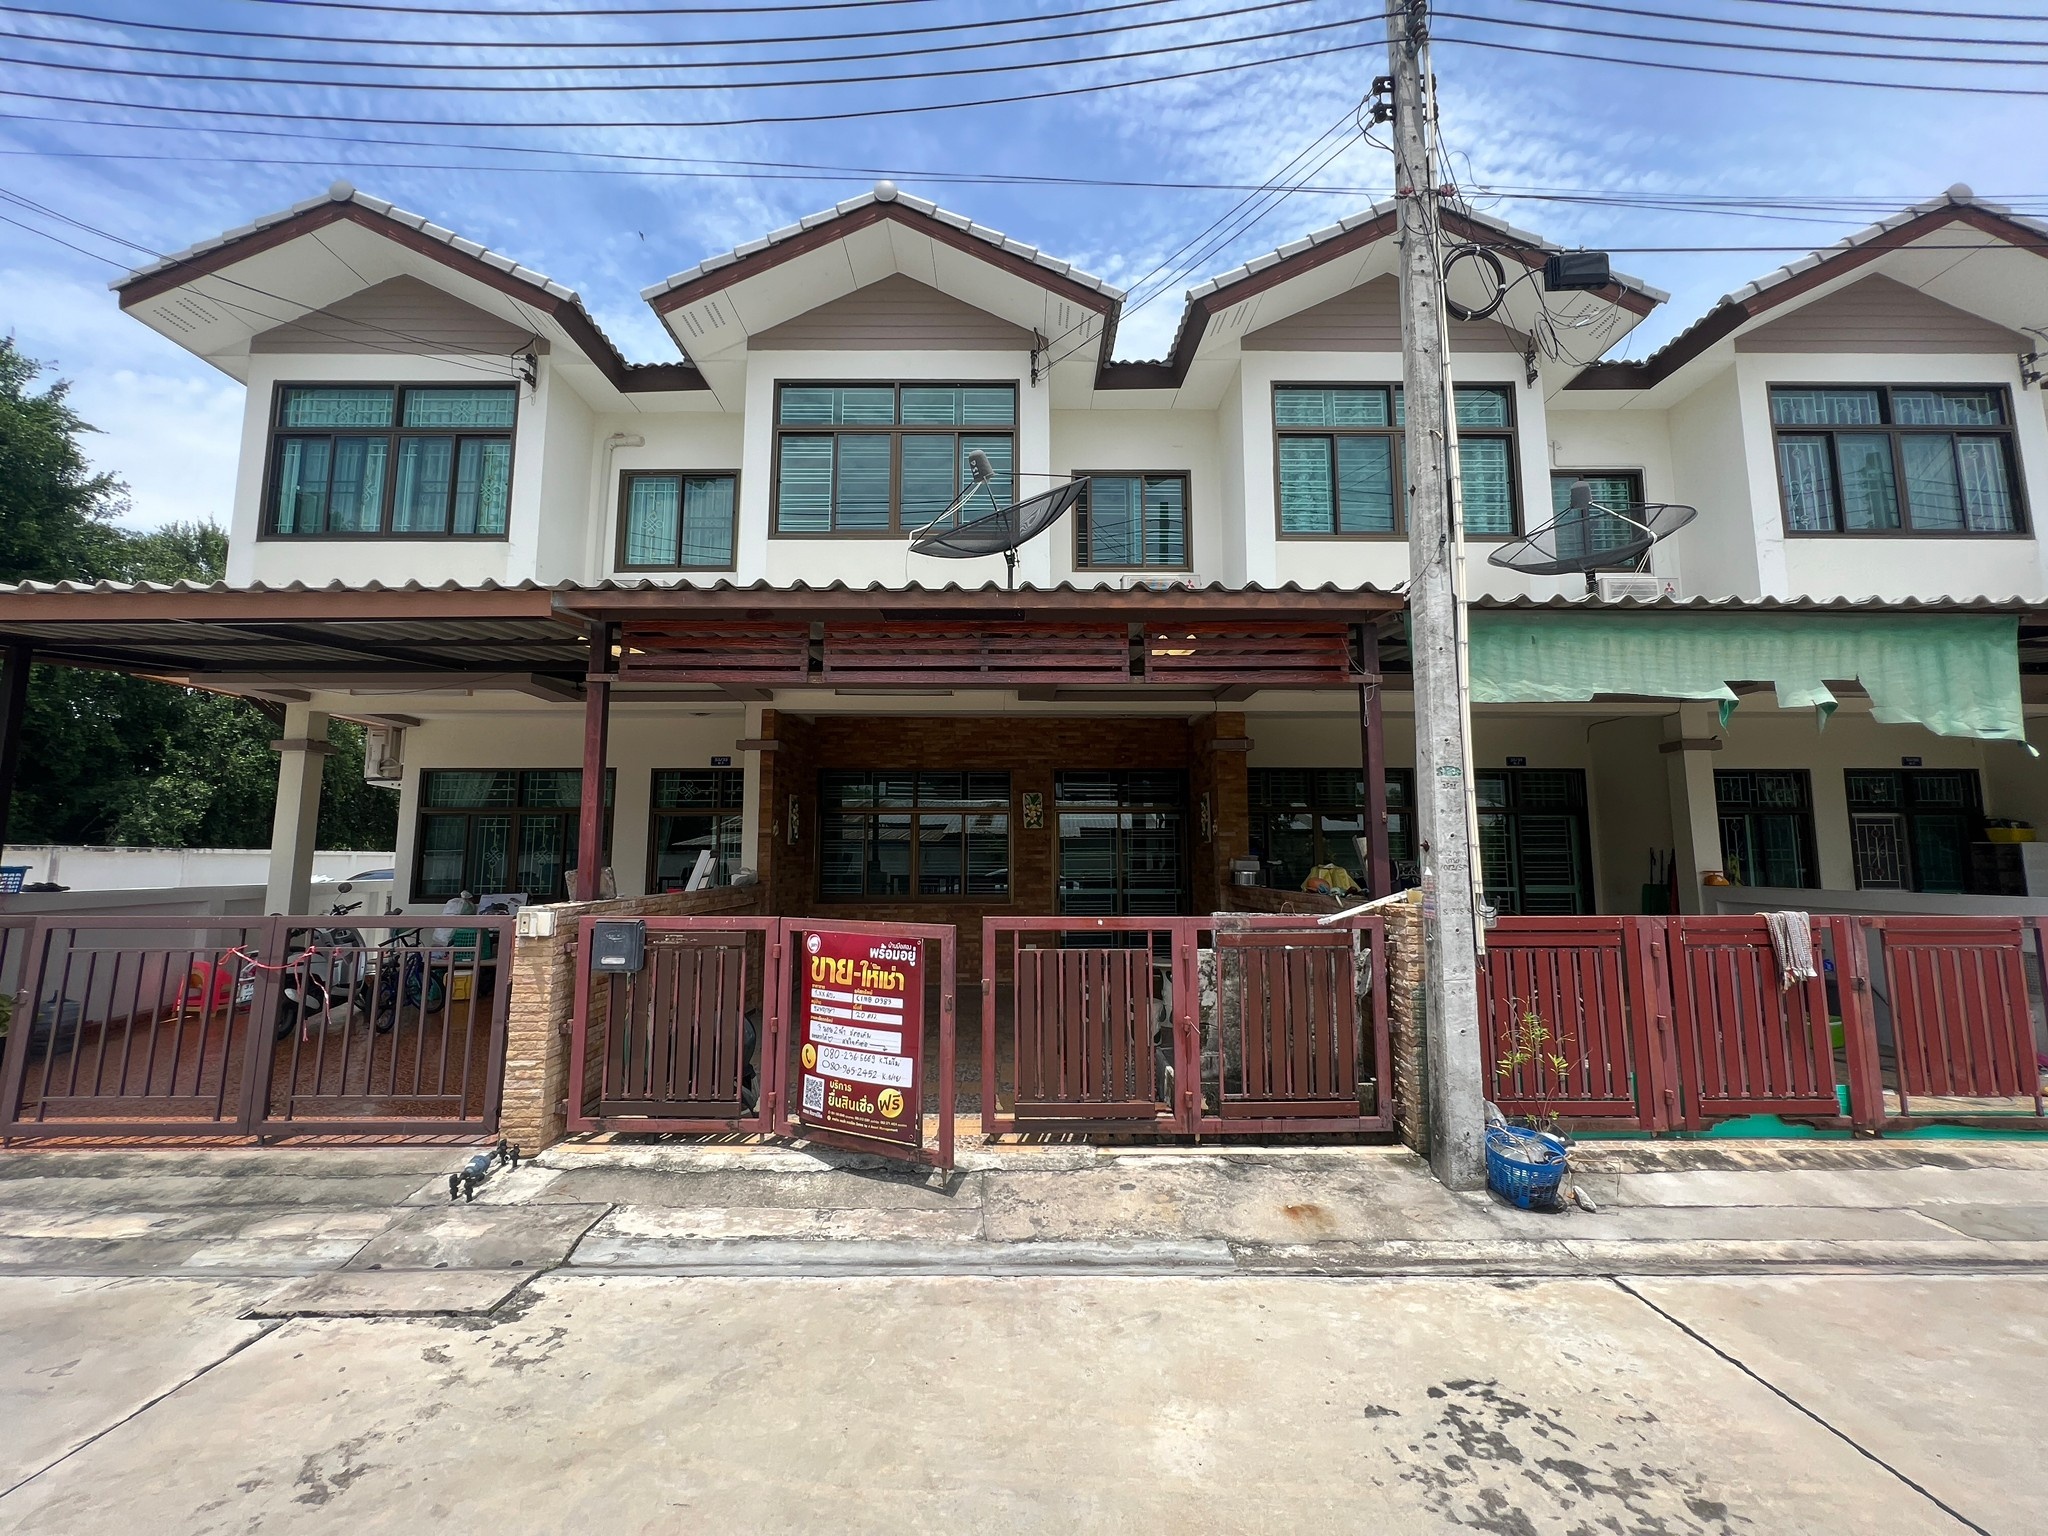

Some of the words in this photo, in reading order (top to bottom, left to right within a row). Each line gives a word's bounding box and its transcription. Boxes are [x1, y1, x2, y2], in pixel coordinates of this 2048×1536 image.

[870, 943, 917, 967] พร้อมอยู่
[829, 1080, 852, 1092] บริการ
[828, 1089, 874, 1114] ยื่นสินเชื่อ
[880, 1094, 901, 1111] ฟรี
